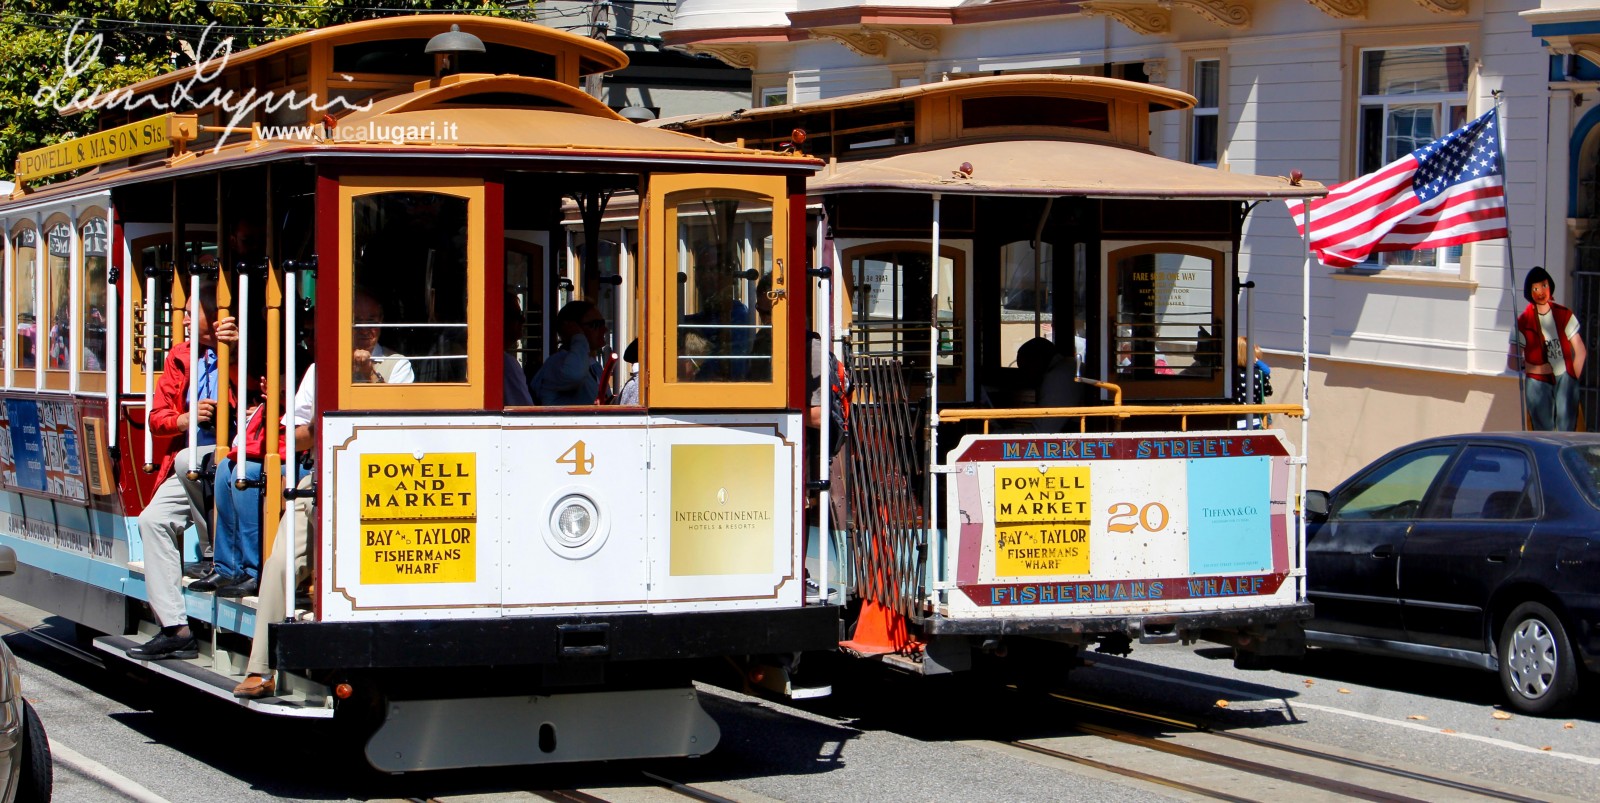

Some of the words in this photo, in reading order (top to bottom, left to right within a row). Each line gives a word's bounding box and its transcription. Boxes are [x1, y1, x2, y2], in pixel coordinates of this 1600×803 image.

[25, 147, 73, 175] POWELL
[76, 143, 86, 163] &
[90, 128, 139, 160] MASON
[143, 123, 166, 146] Sts.
[1133, 272, 1149, 281] FARE
[1182, 272, 1196, 280] WAY
[1003, 441, 1114, 460] MARKET
[1136, 439, 1232, 458] STREET
[555, 440, 595, 476] 4
[367, 463, 469, 478] POWELL
[395, 479, 445, 490] AND
[1001, 476, 1085, 490] POWELL
[365, 492, 471, 507] MARKET
[1024, 490, 1065, 501] AND
[1000, 501, 1087, 515] MARKET
[1107, 501, 1169, 533] 20
[688, 523, 715, 531] HOTELS
[725, 522, 756, 530] RESORTS
[366, 529, 394, 547] BAY
[414, 527, 471, 545] TAYLOR
[1040, 528, 1087, 544] TAYLOR
[374, 548, 461, 563] FISHERMANS
[1007, 546, 1079, 560] FISHERMANS
[395, 562, 441, 575] WHARF
[1025, 558, 1062, 570] WHARF
[991, 582, 1164, 605] FISHERMANS
[1188, 575, 1264, 597] WHARF
